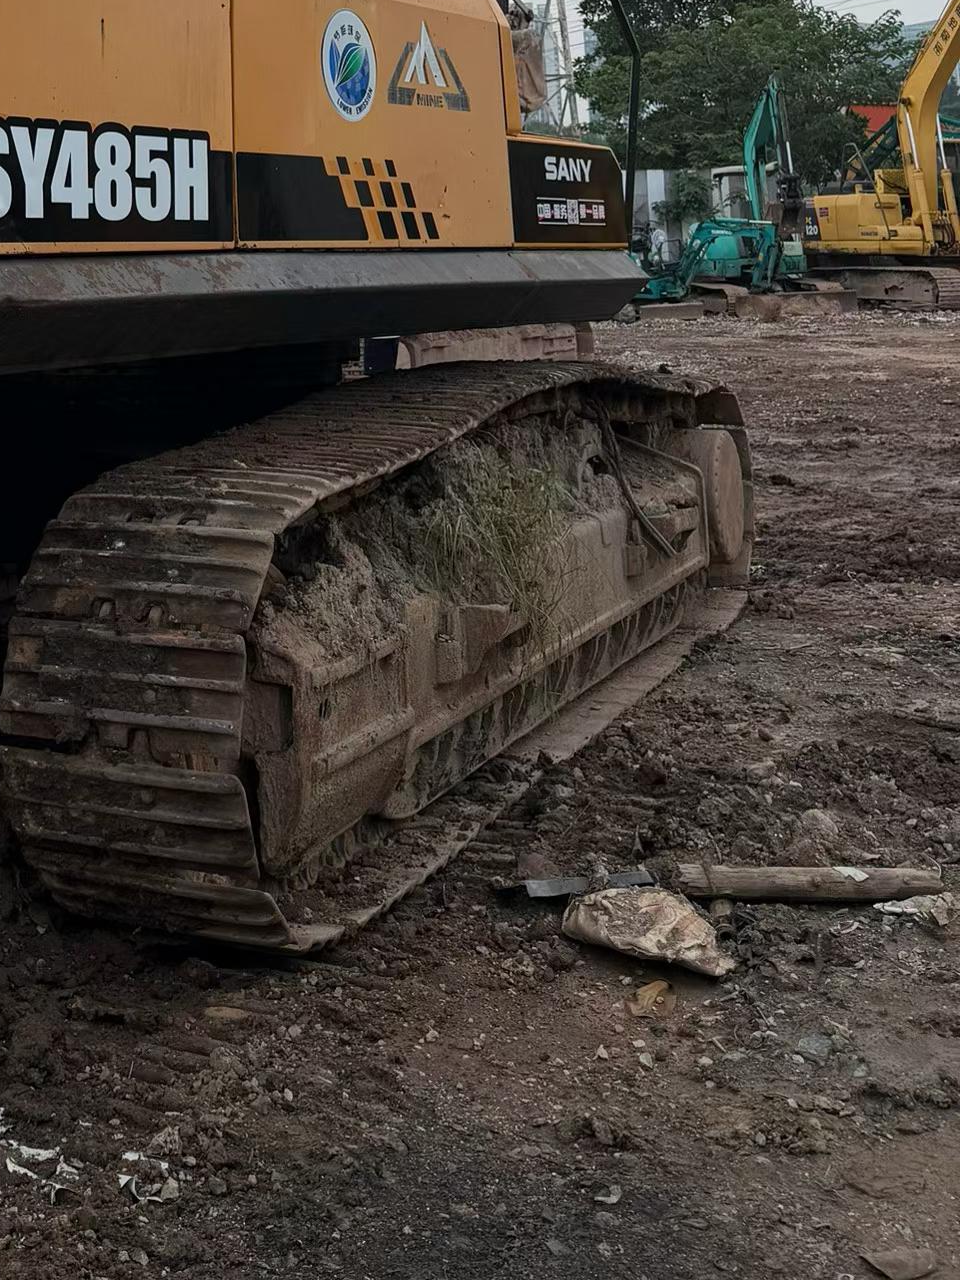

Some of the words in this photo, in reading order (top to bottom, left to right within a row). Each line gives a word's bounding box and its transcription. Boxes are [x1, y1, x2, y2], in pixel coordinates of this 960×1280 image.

[337, 97, 352, 115] LOWER
[416, 92, 444, 109] MINE
[543, 155, 592, 183] SANY
